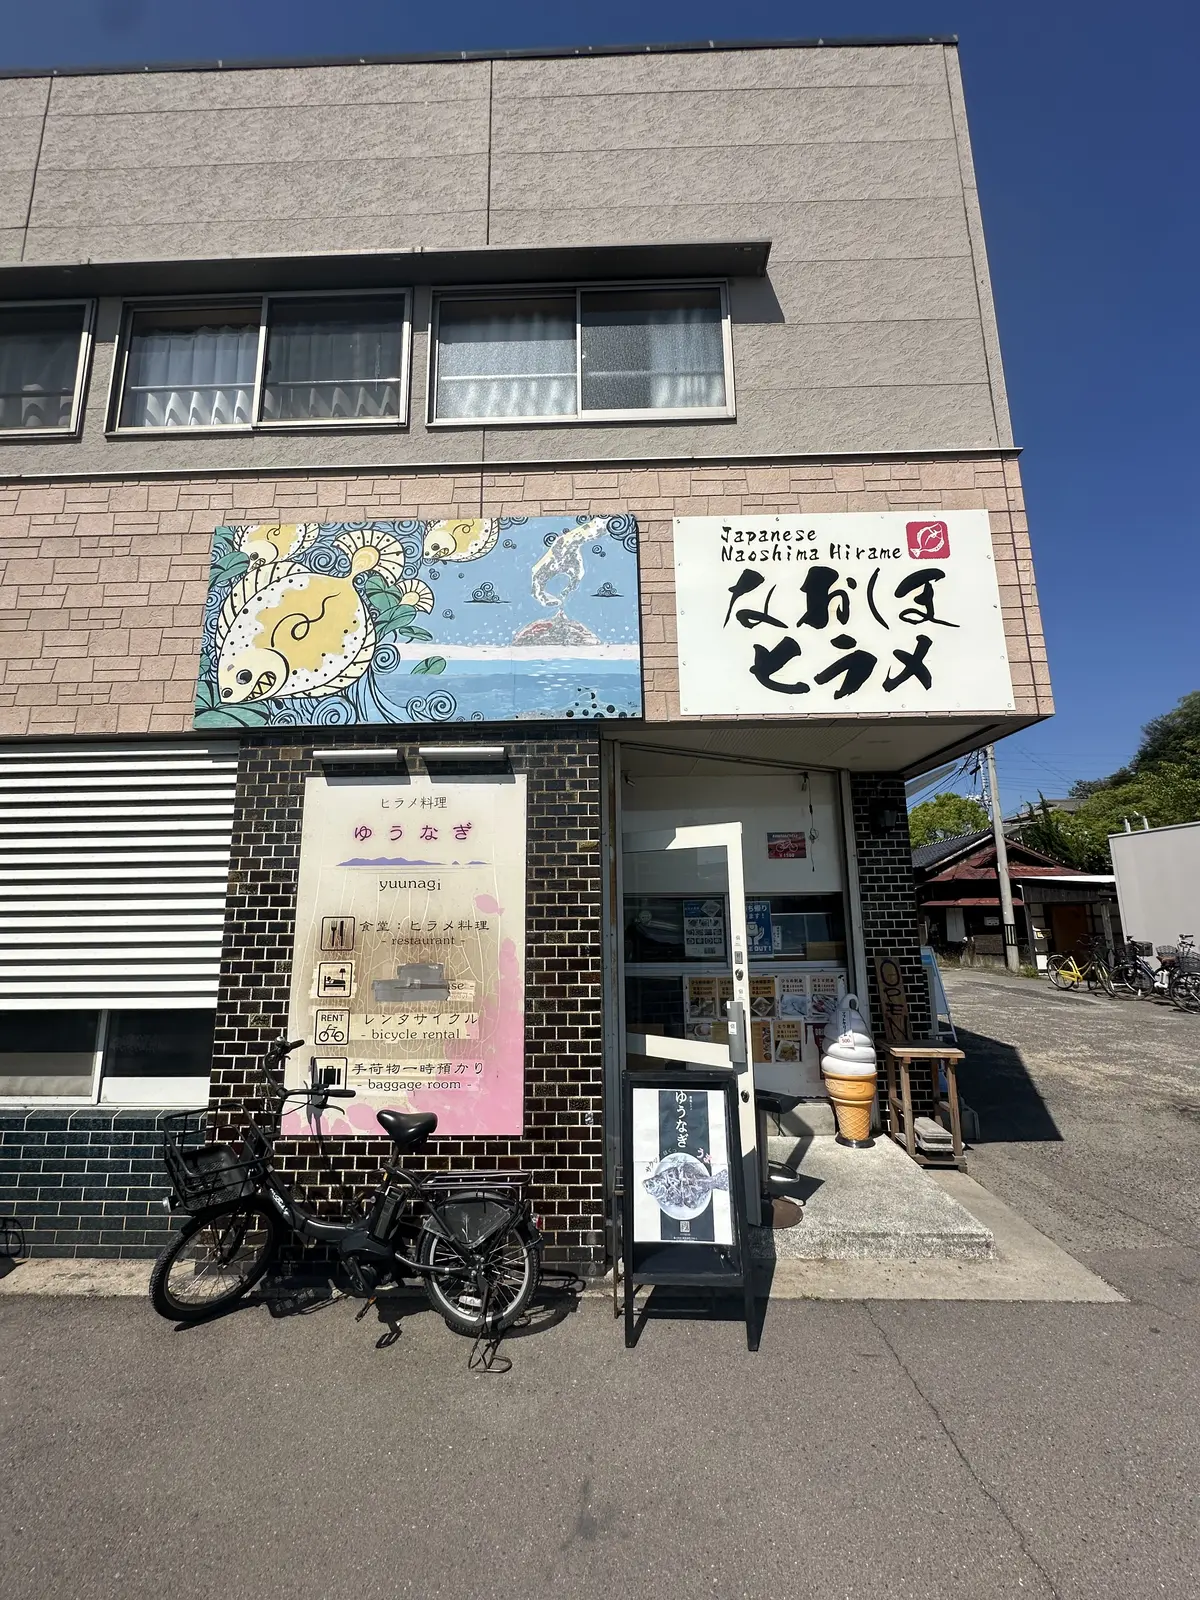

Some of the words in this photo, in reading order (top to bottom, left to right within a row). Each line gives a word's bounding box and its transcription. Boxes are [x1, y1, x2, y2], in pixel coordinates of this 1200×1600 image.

[720, 525, 818, 545] Japanese
[720, 544, 820, 562] Naoshima
[829, 543, 902, 560] Hirame
[723, 565, 960, 630] なおしま
[749, 633, 933, 700] ヒラメ
[380, 796, 448, 809] ヒラメ料理
[354, 821, 473, 842] ゆうなぎ
[378, 878, 442, 892] yuunagi
[391, 936, 456, 946] restaurant
[880, 958, 909, 1042] OPEN
[321, 1014, 344, 1022] RENT
[364, 1014, 479, 1025] レンタサイクル
[371, 1028, 418, 1040] bicycle
[422, 1029, 460, 1039] rental
[351, 1062, 484, 1075] 手荷物一時預かり
[368, 1078, 422, 1092] baggage
[427, 1080, 461, 1089] room
[675, 1090, 689, 1148] ゆうなぎ
